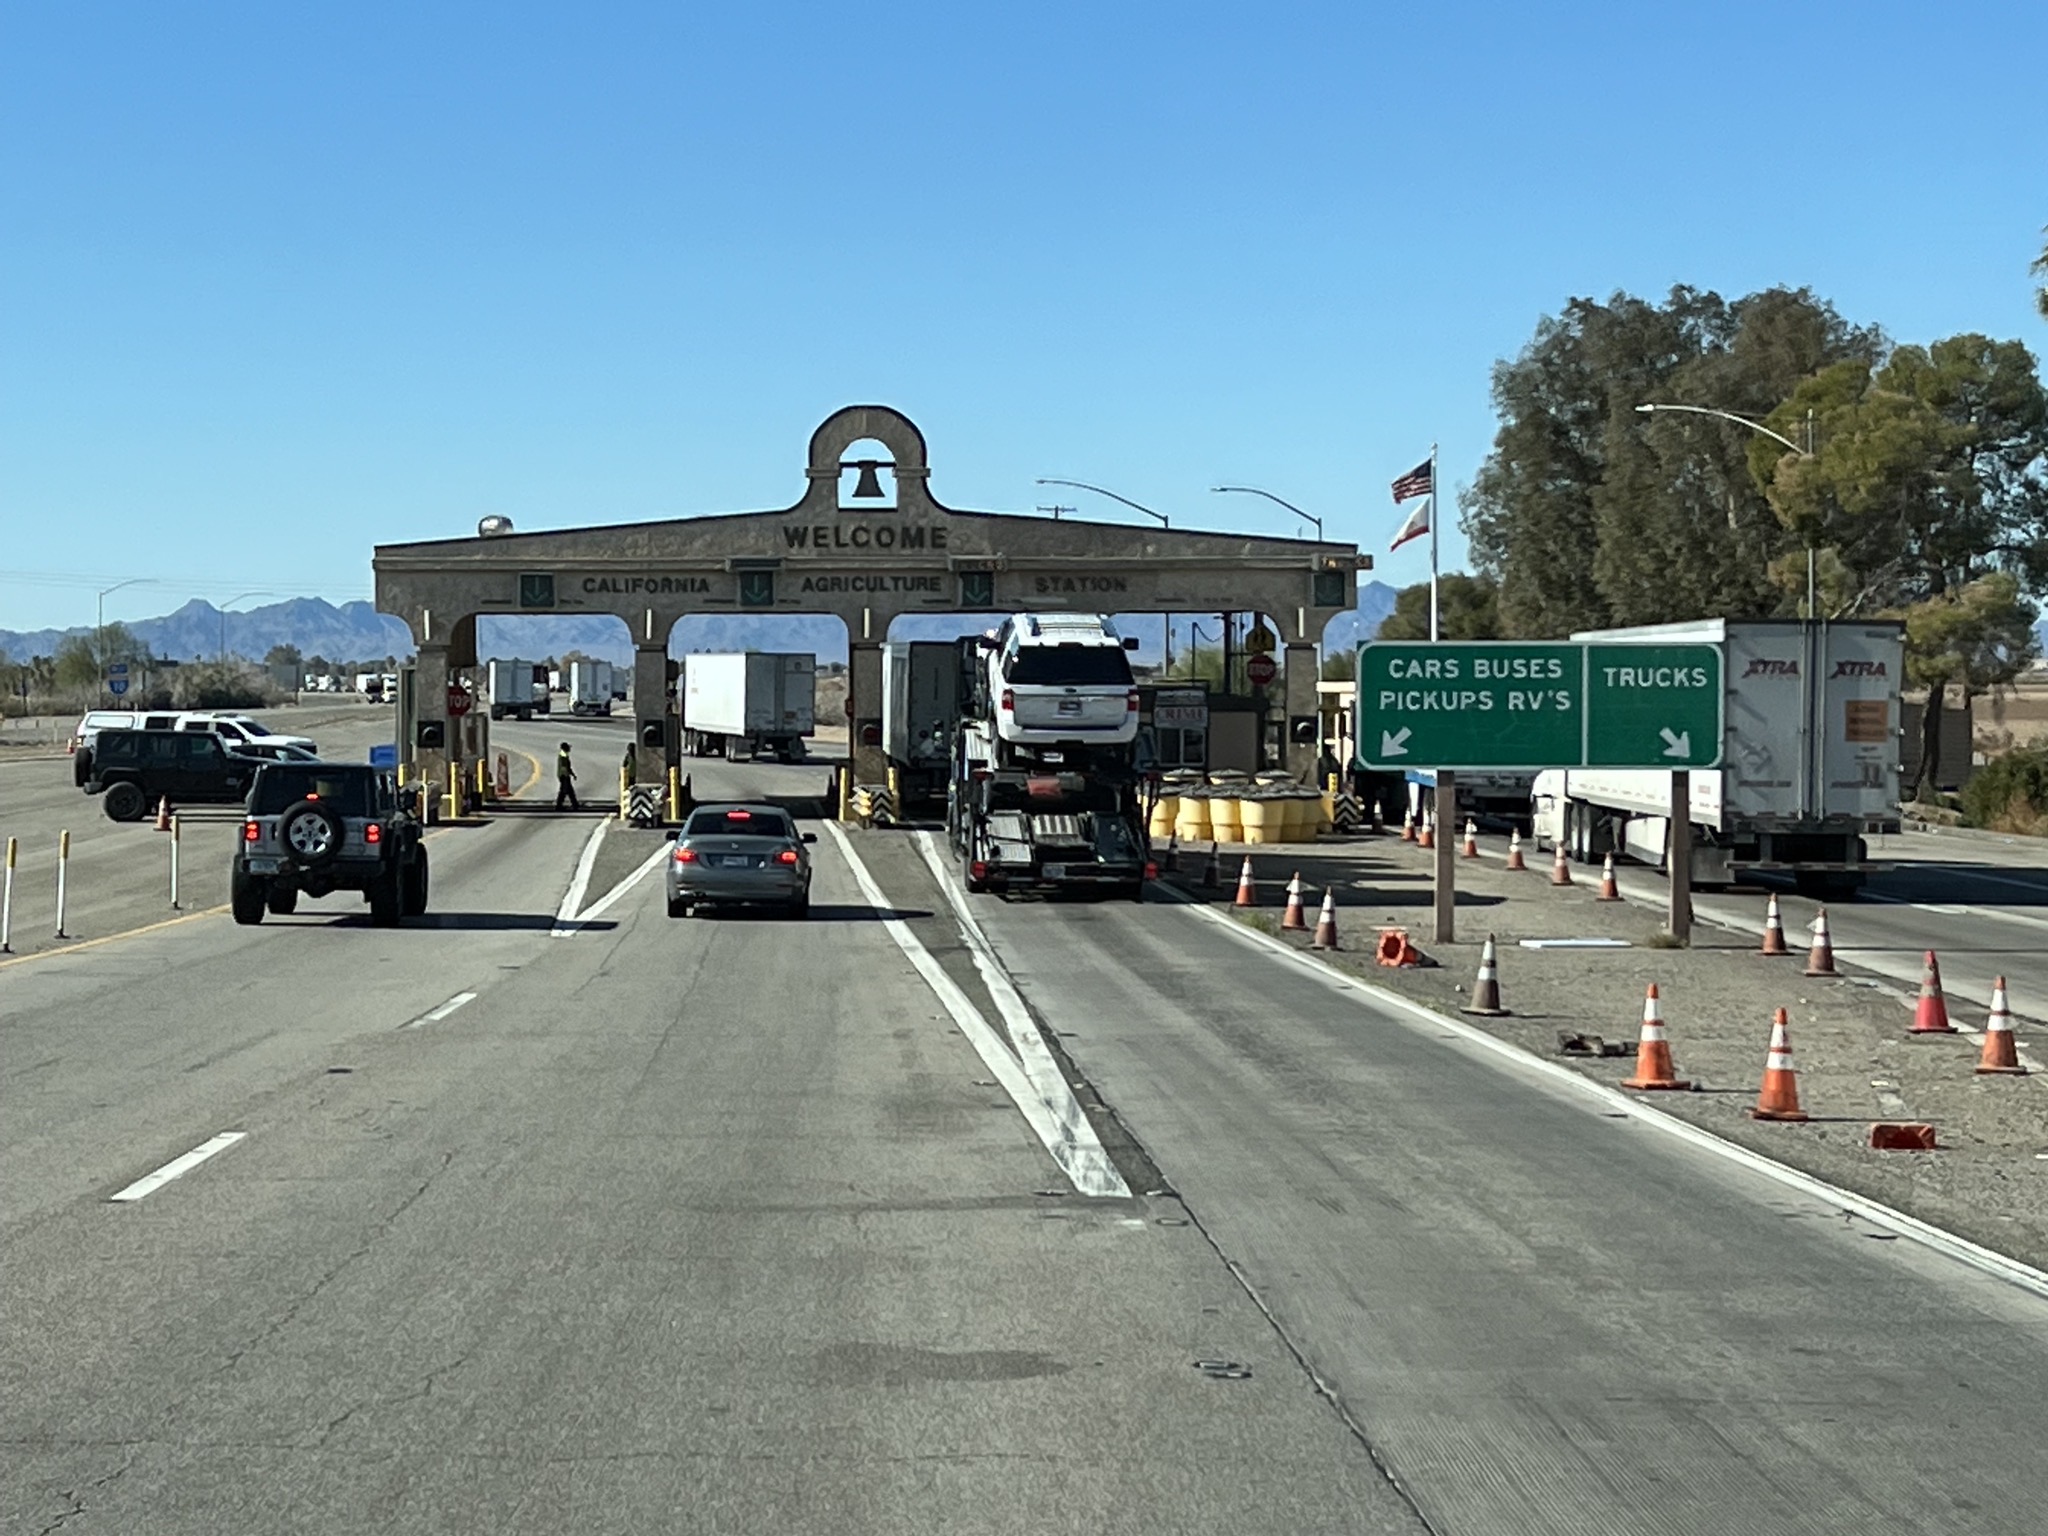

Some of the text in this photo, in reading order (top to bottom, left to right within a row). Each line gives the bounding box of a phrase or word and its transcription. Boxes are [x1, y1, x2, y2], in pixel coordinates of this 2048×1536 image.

[783, 525, 948, 549] WELCOME
[583, 576, 1128, 594] CALIFORNIA AGRICULTURE STATION
[1388, 659, 1563, 679] CARS BUSES
[1603, 667, 1708, 688] TRUCKS
[1741, 659, 1799, 679] XTRA
[1828, 660, 1887, 680] XTRA
[1379, 690, 1571, 711] PICKUPS RV'S
